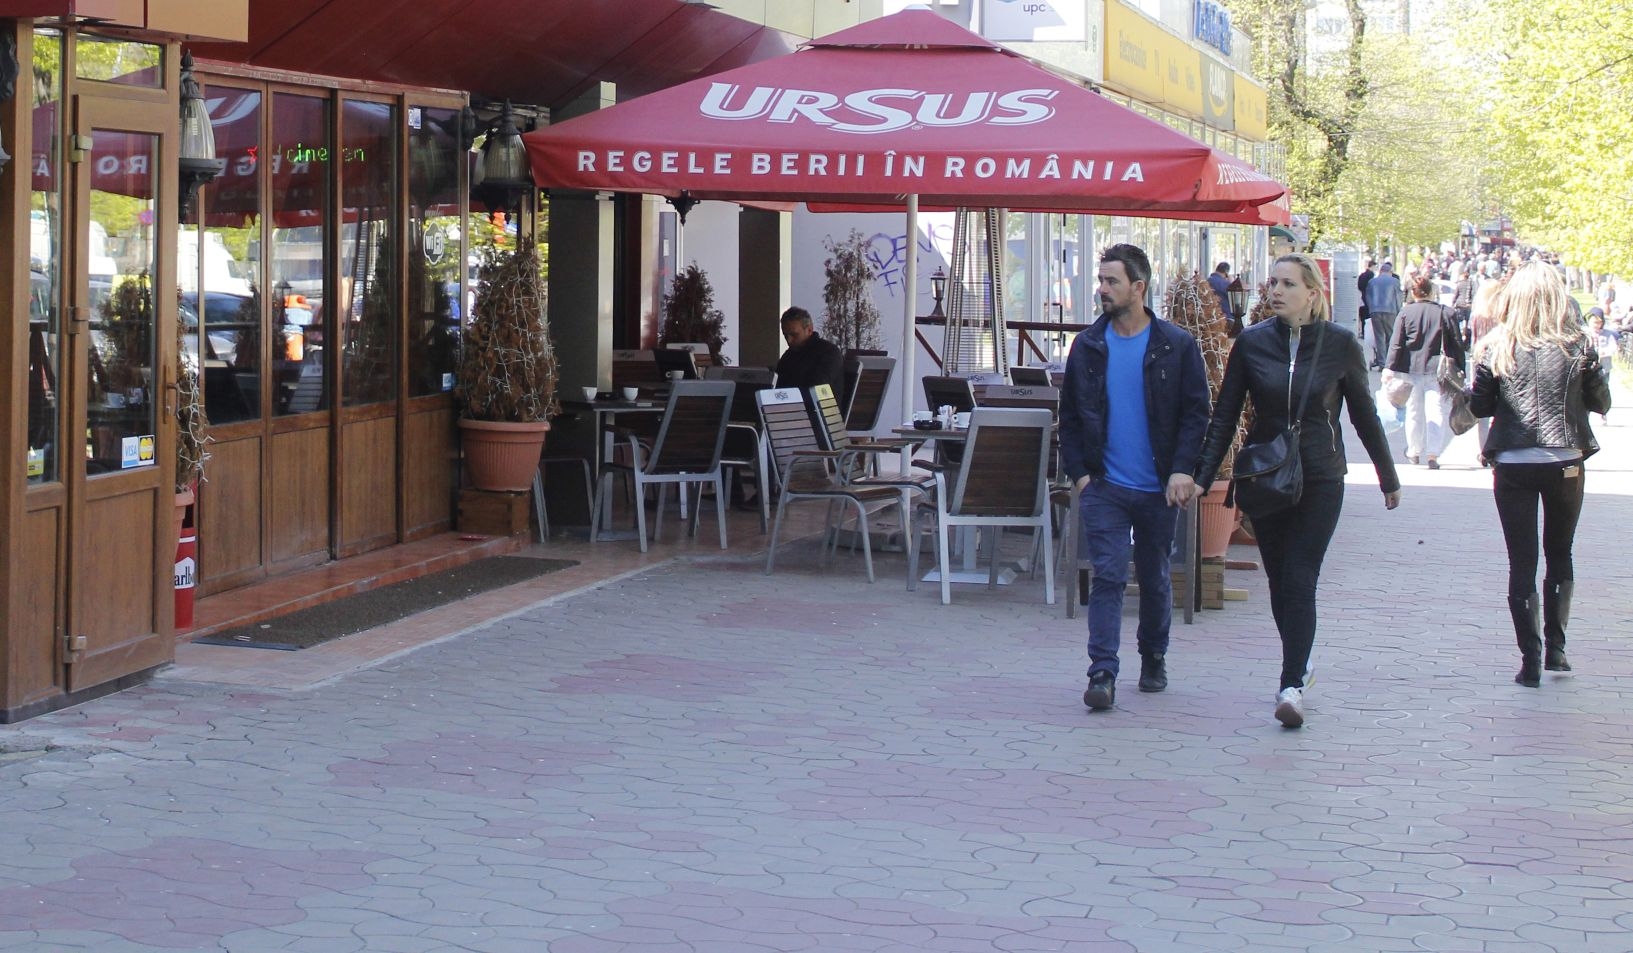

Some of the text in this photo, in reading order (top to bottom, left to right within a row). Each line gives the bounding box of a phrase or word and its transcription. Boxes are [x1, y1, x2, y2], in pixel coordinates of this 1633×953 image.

[1022, 3, 1047, 16] upc
[700, 82, 1060, 135] URSUS
[577, 150, 1145, 183] REGELE BERII ÎN ROMÂNIA
